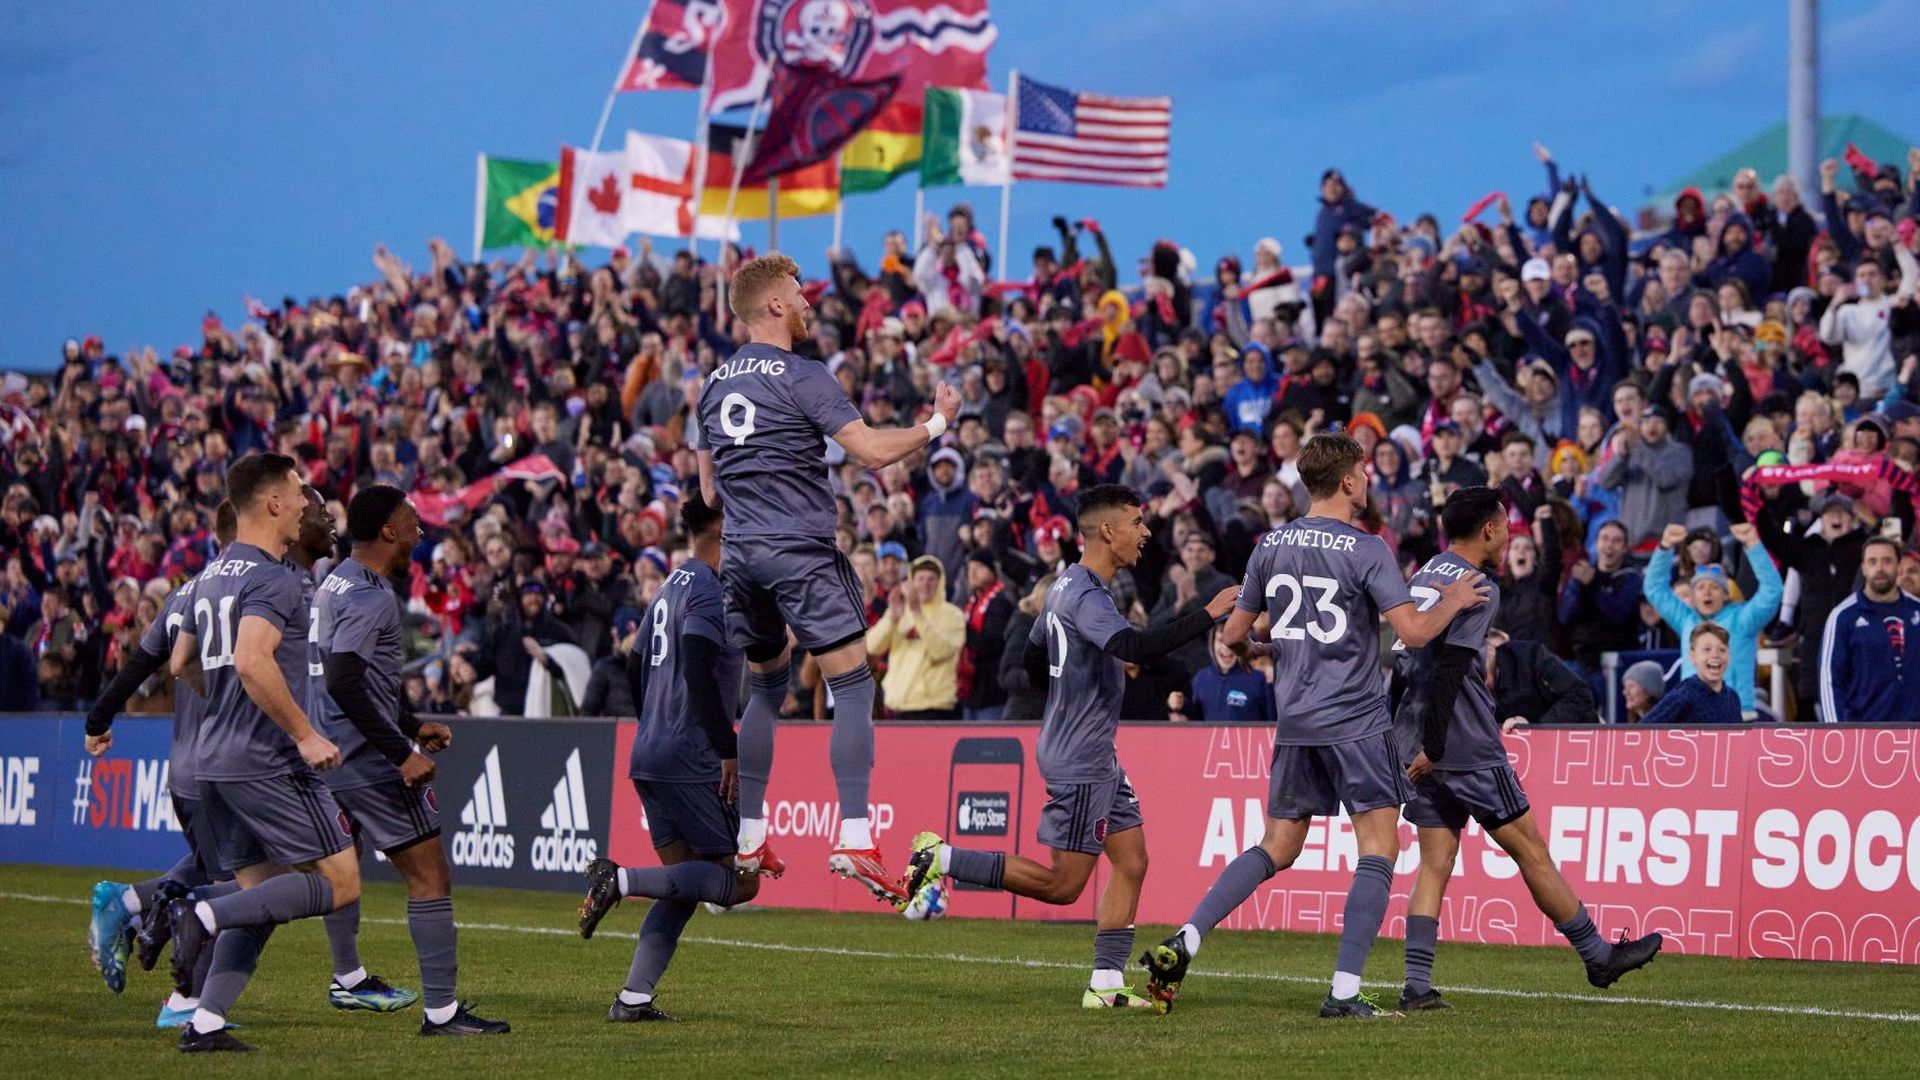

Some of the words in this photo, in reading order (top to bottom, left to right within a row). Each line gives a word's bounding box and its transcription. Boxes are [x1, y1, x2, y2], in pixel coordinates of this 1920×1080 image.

[721, 392, 756, 446] 9
[1263, 529, 1357, 552] SCHNEIDER
[193, 595, 236, 671] 21
[651, 598, 669, 667] 8
[1265, 573, 1348, 644] 23
[1553, 729, 1746, 787] FIRST
[1758, 728, 1920, 789] SOC
[0, 756, 40, 825] DE
[971, 808, 987, 831] App
[987, 808, 1006, 827] Store
[452, 822, 515, 868] adidas
[531, 827, 597, 873] adidas
[1549, 806, 1739, 887] FIRST
[1752, 808, 1920, 892] SOC
[1750, 909, 1920, 964] SOC
